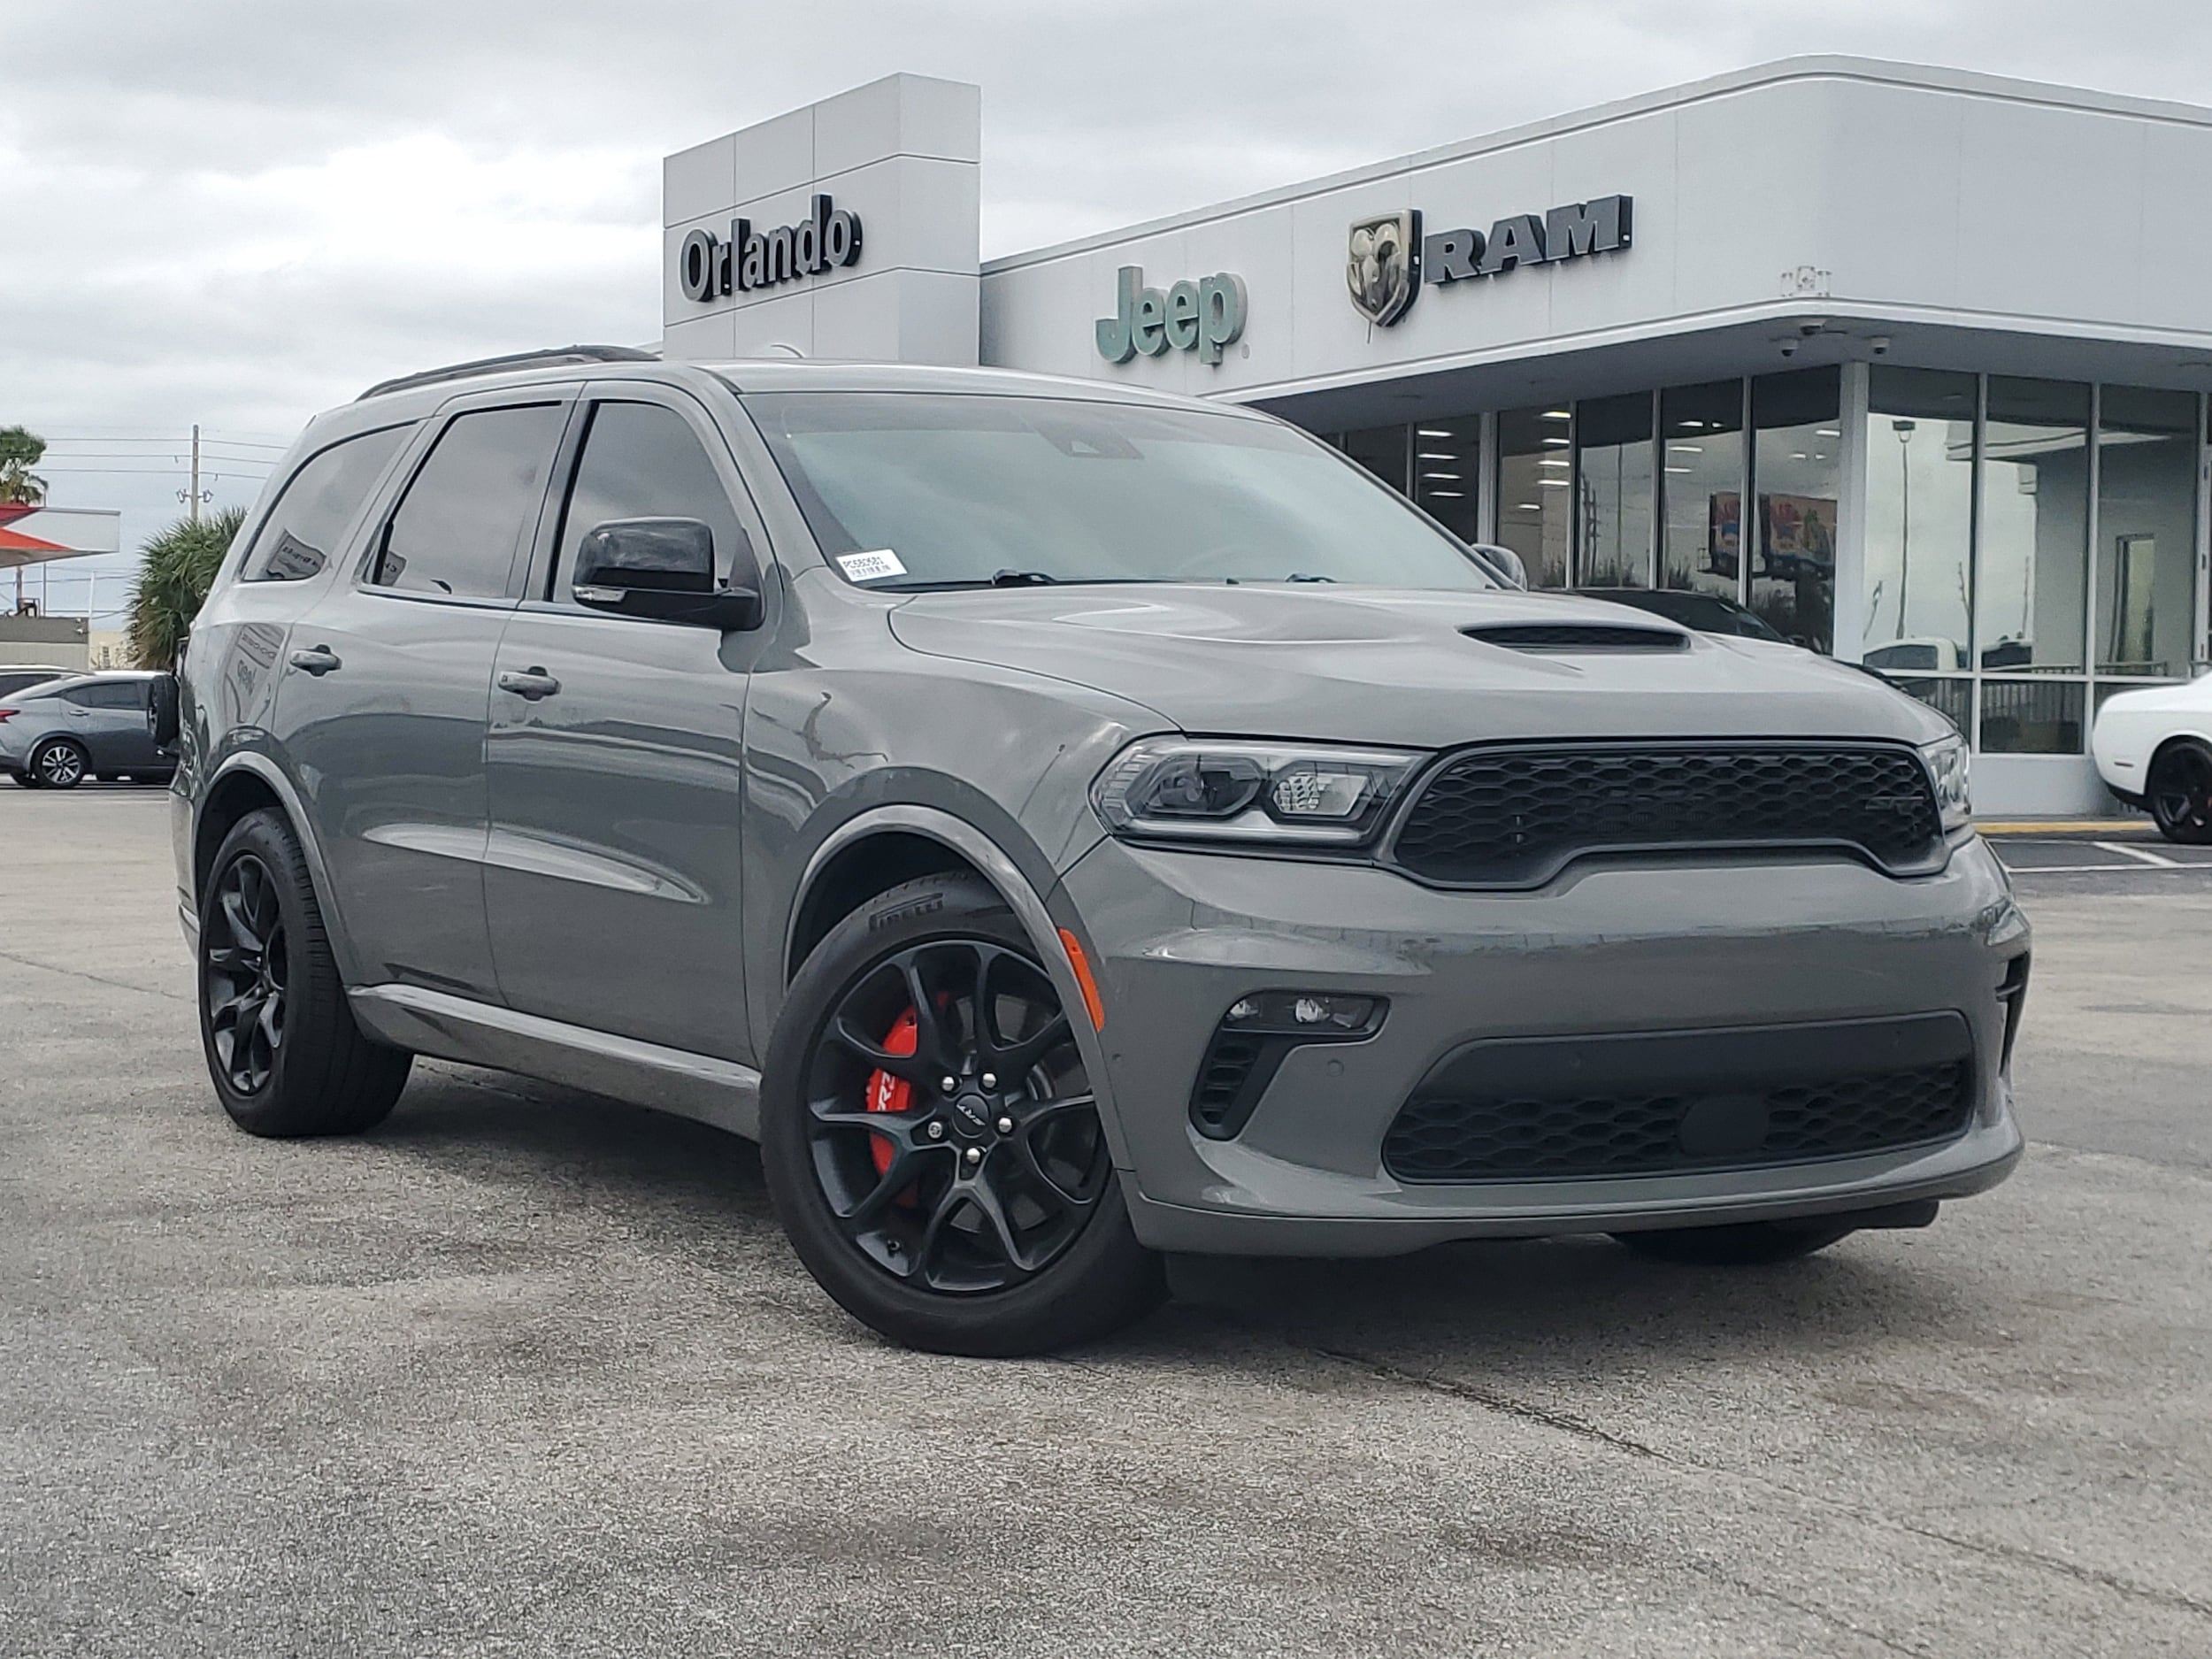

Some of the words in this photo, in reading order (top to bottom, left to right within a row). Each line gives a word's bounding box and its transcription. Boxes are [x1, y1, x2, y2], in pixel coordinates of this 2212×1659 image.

[680, 192, 864, 302] Orlando
[1424, 195, 1633, 285] RAM
[1095, 265, 1248, 365] Jeep
